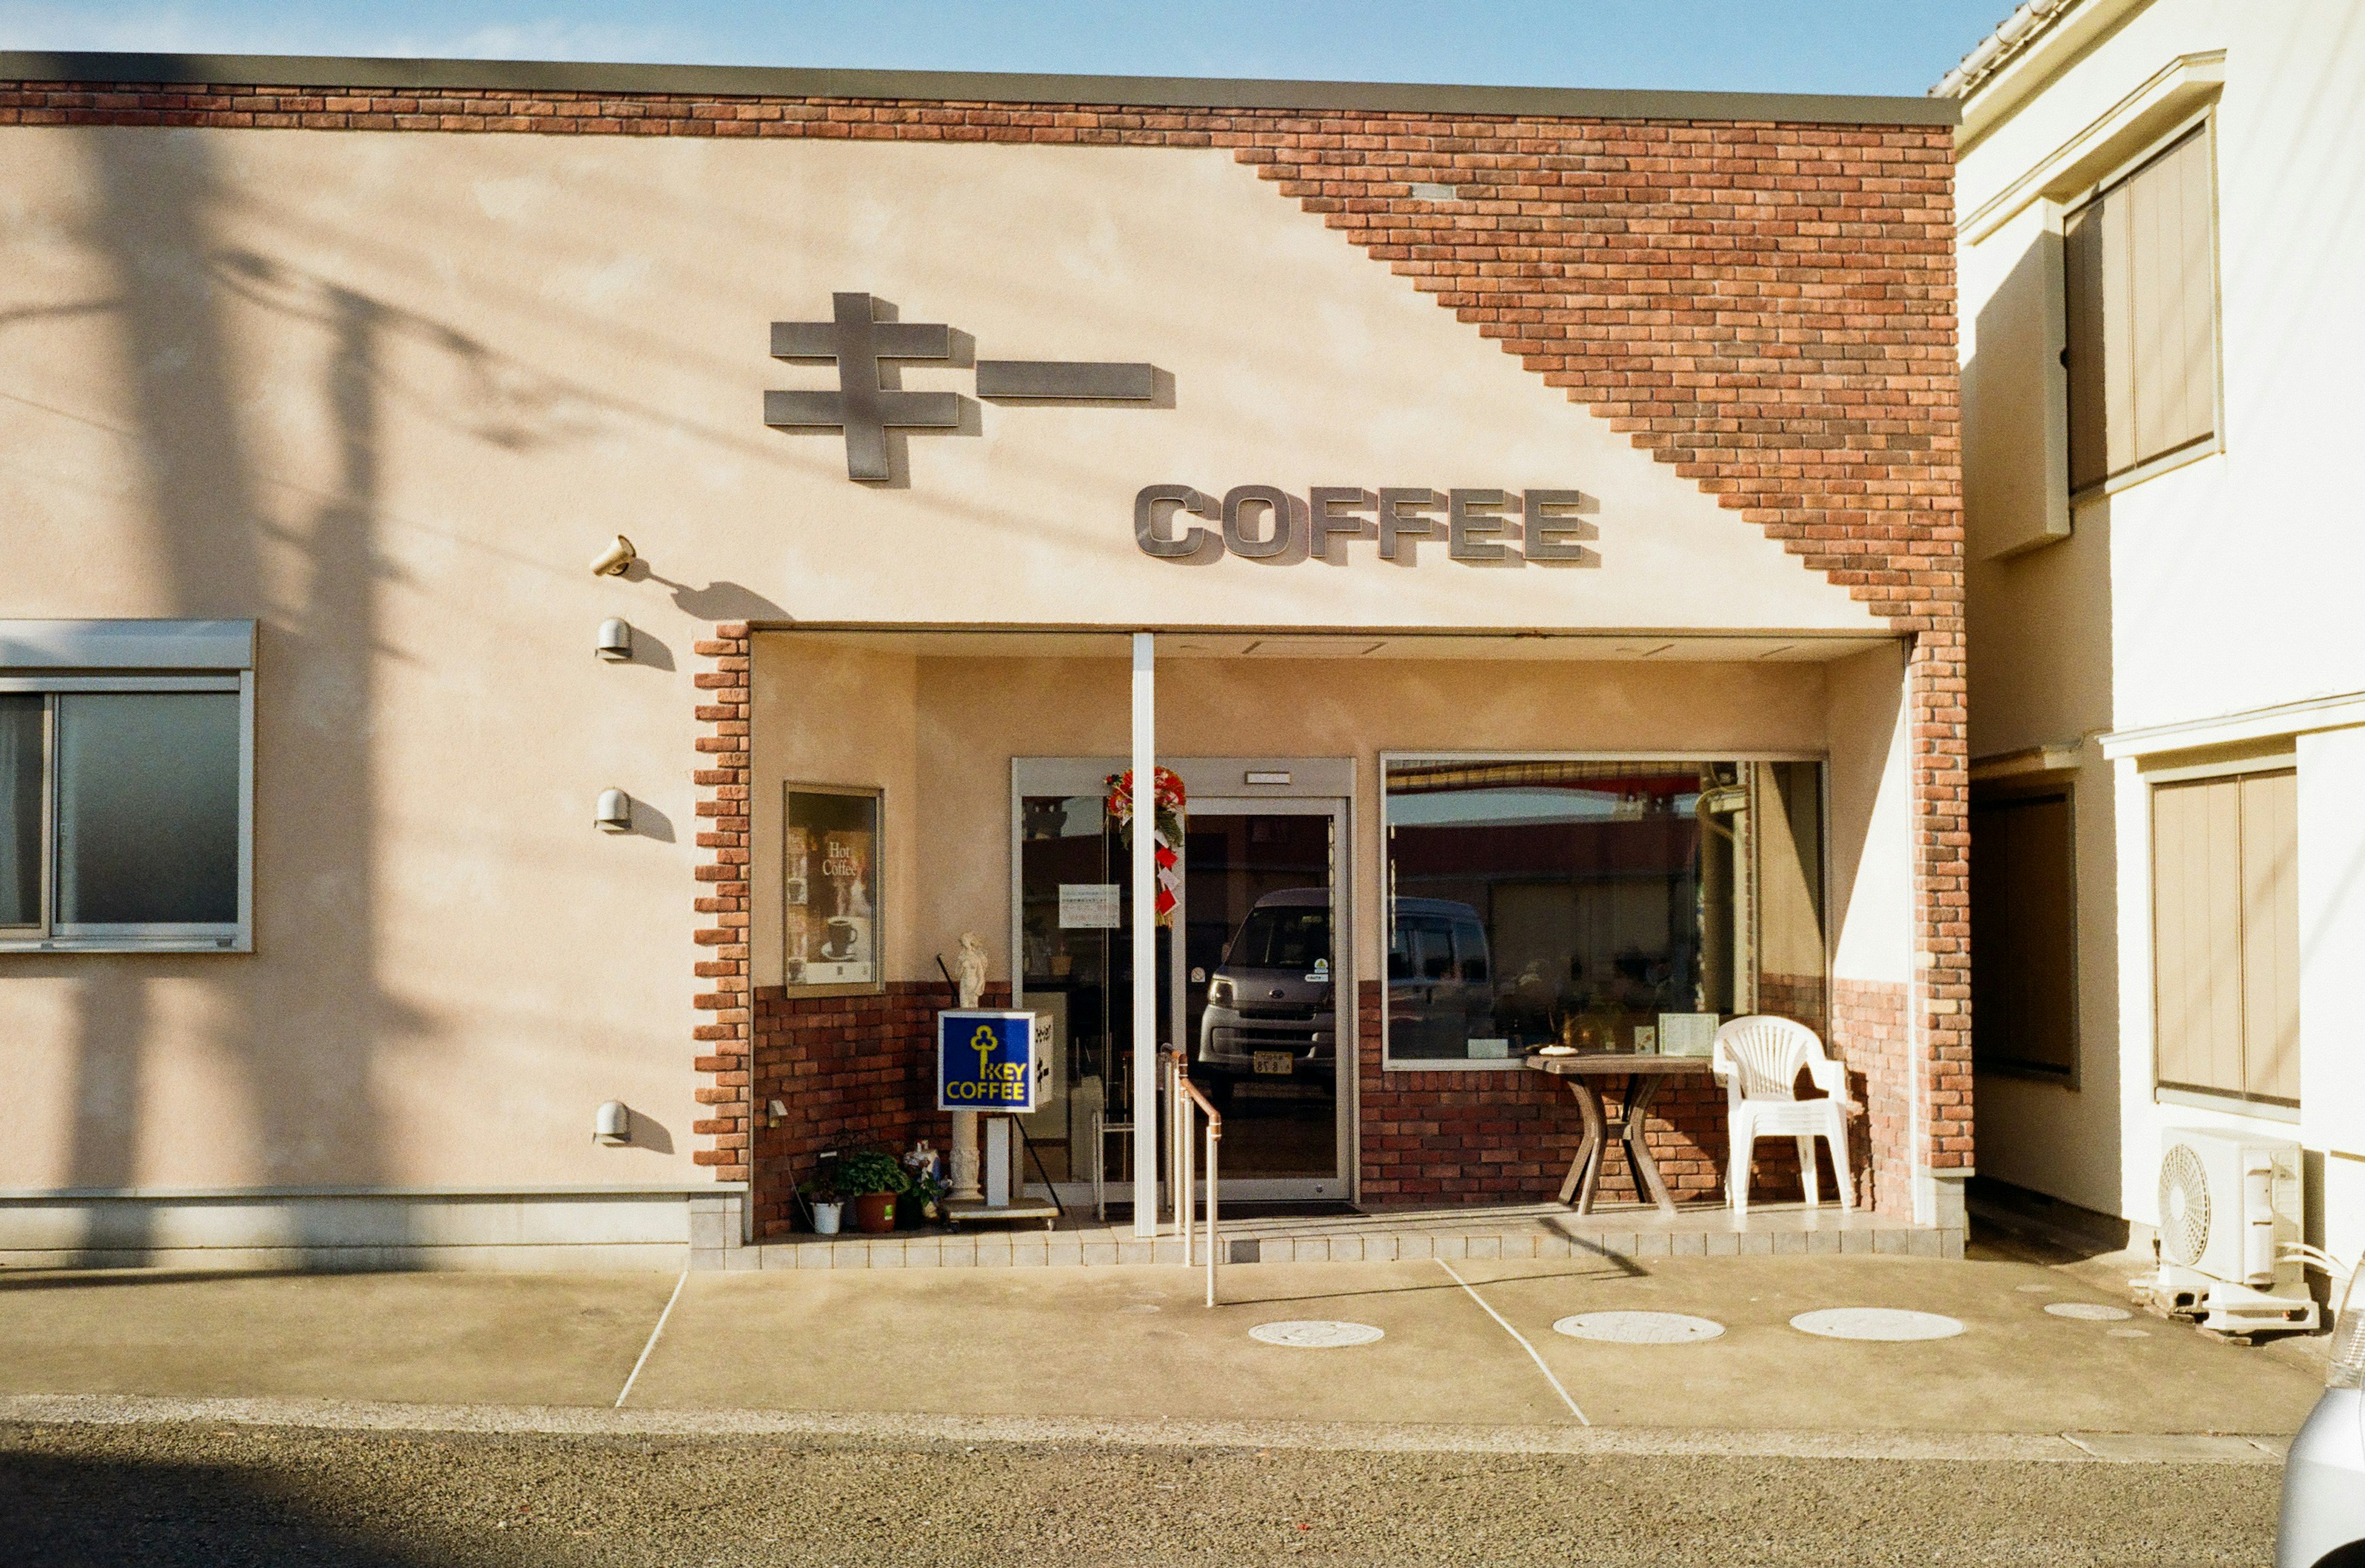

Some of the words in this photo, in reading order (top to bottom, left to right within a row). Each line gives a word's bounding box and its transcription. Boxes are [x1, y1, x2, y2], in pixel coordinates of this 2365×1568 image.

[764, 292, 1153, 480] キー
[1133, 483, 1583, 560] COFFEE
[830, 841, 850, 857] Hot
[822, 859, 857, 876] Coffee
[987, 1063, 1027, 1081] KEY
[946, 1081, 1025, 1101] COFFEE
